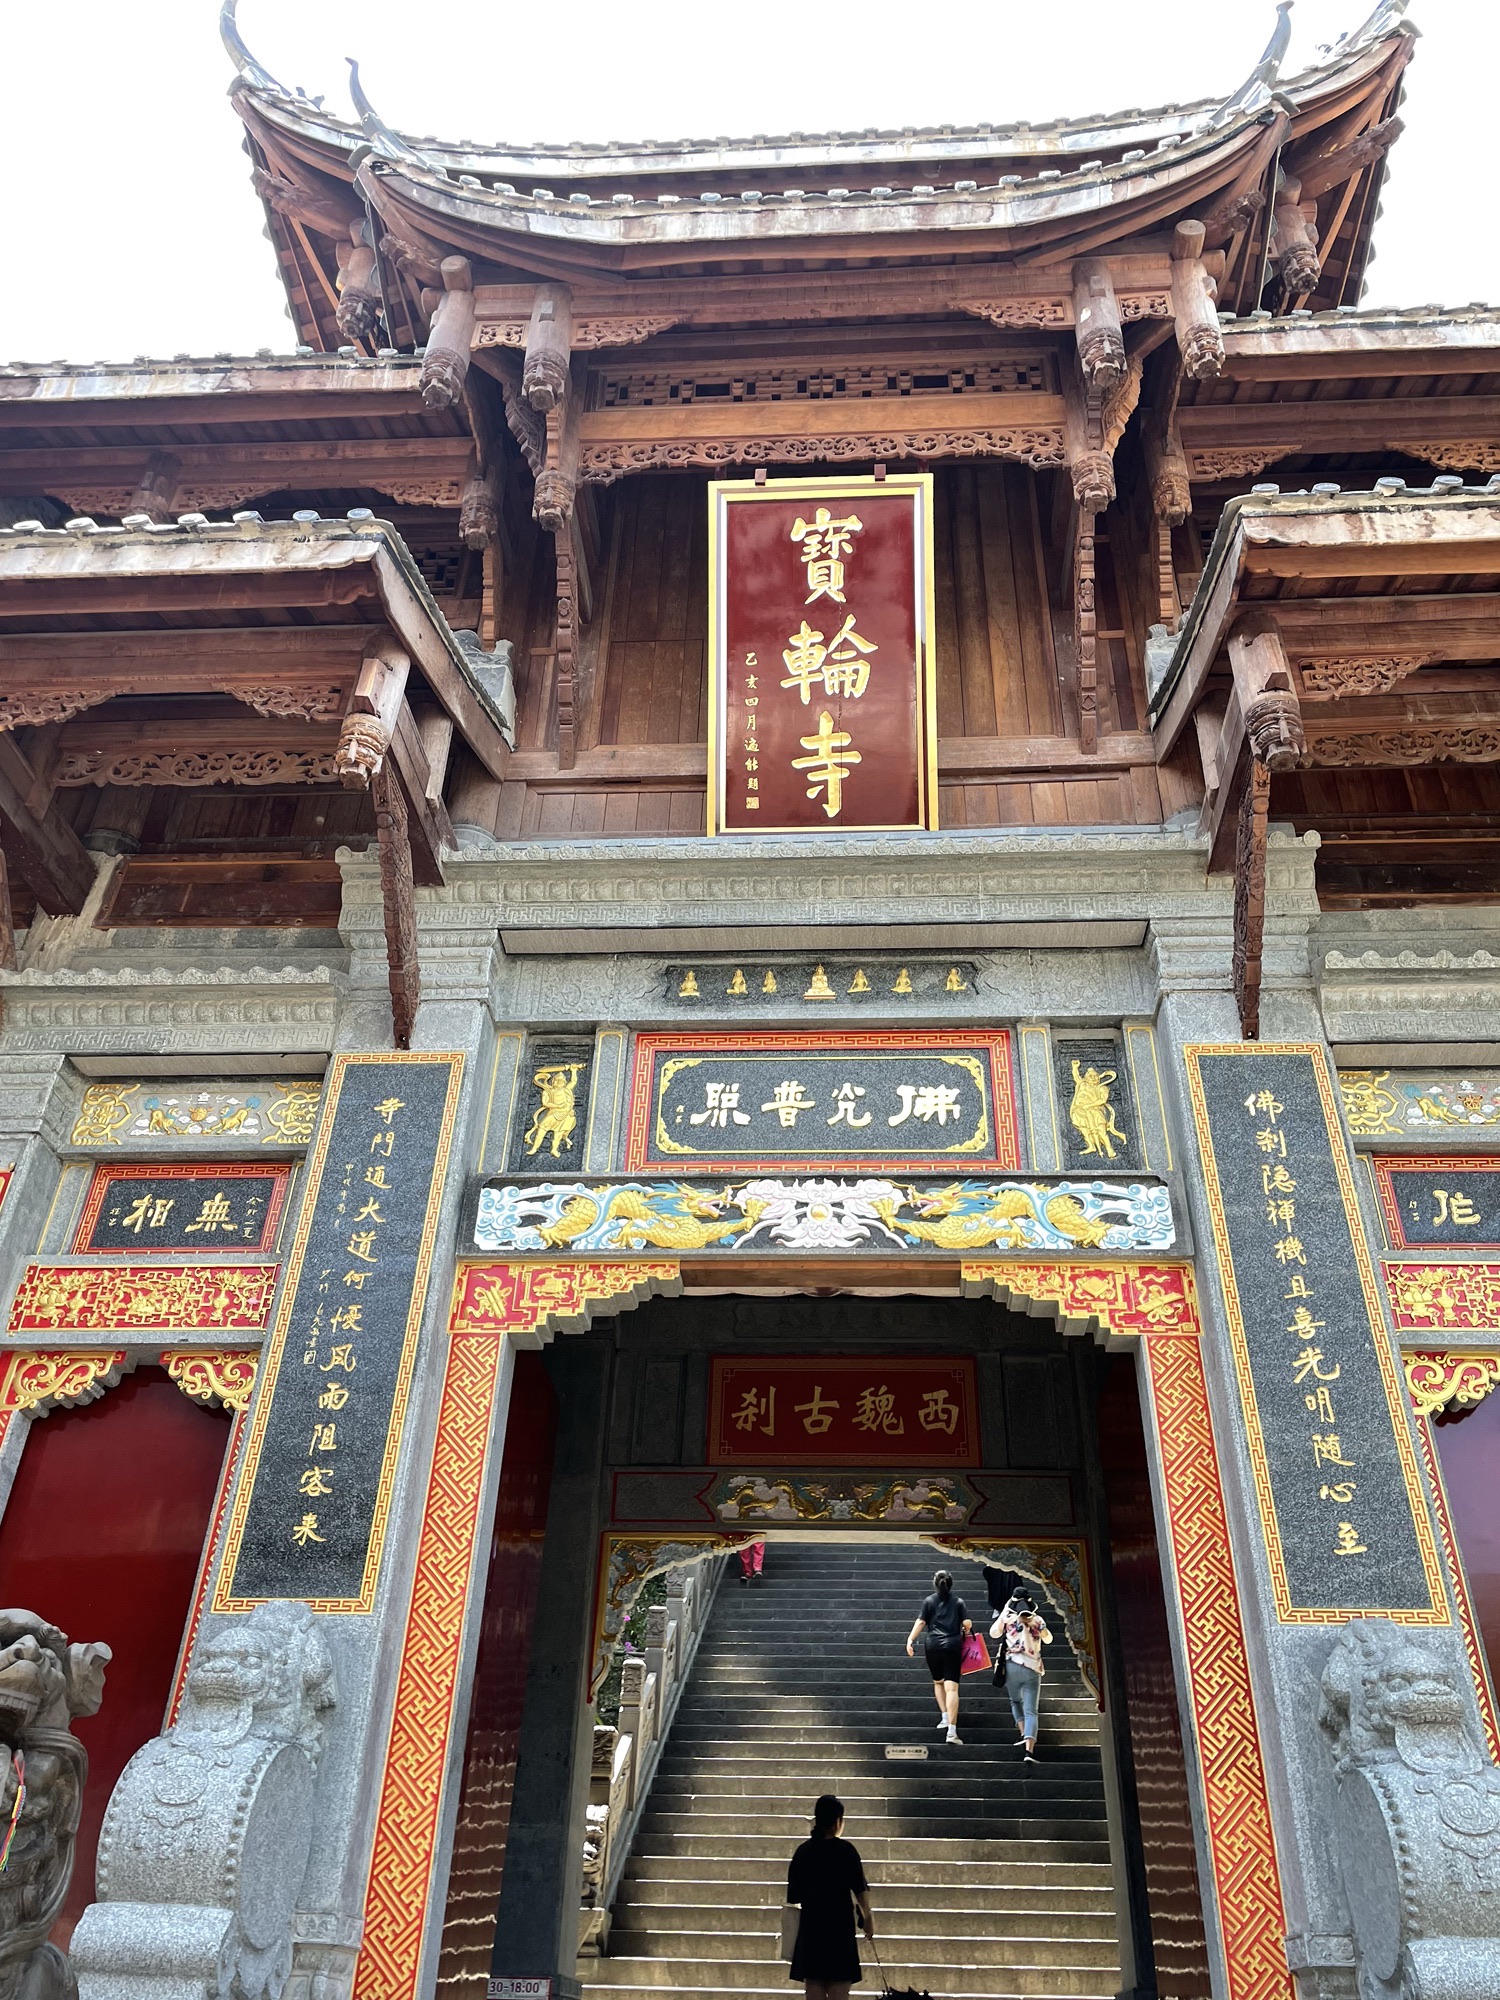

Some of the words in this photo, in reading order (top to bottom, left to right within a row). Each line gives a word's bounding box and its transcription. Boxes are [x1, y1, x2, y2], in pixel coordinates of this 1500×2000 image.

[780, 507, 879, 818] 寶輪寺
[689, 1080, 961, 1128] 佛光普照
[731, 1384, 960, 1437] 西魏古刹
